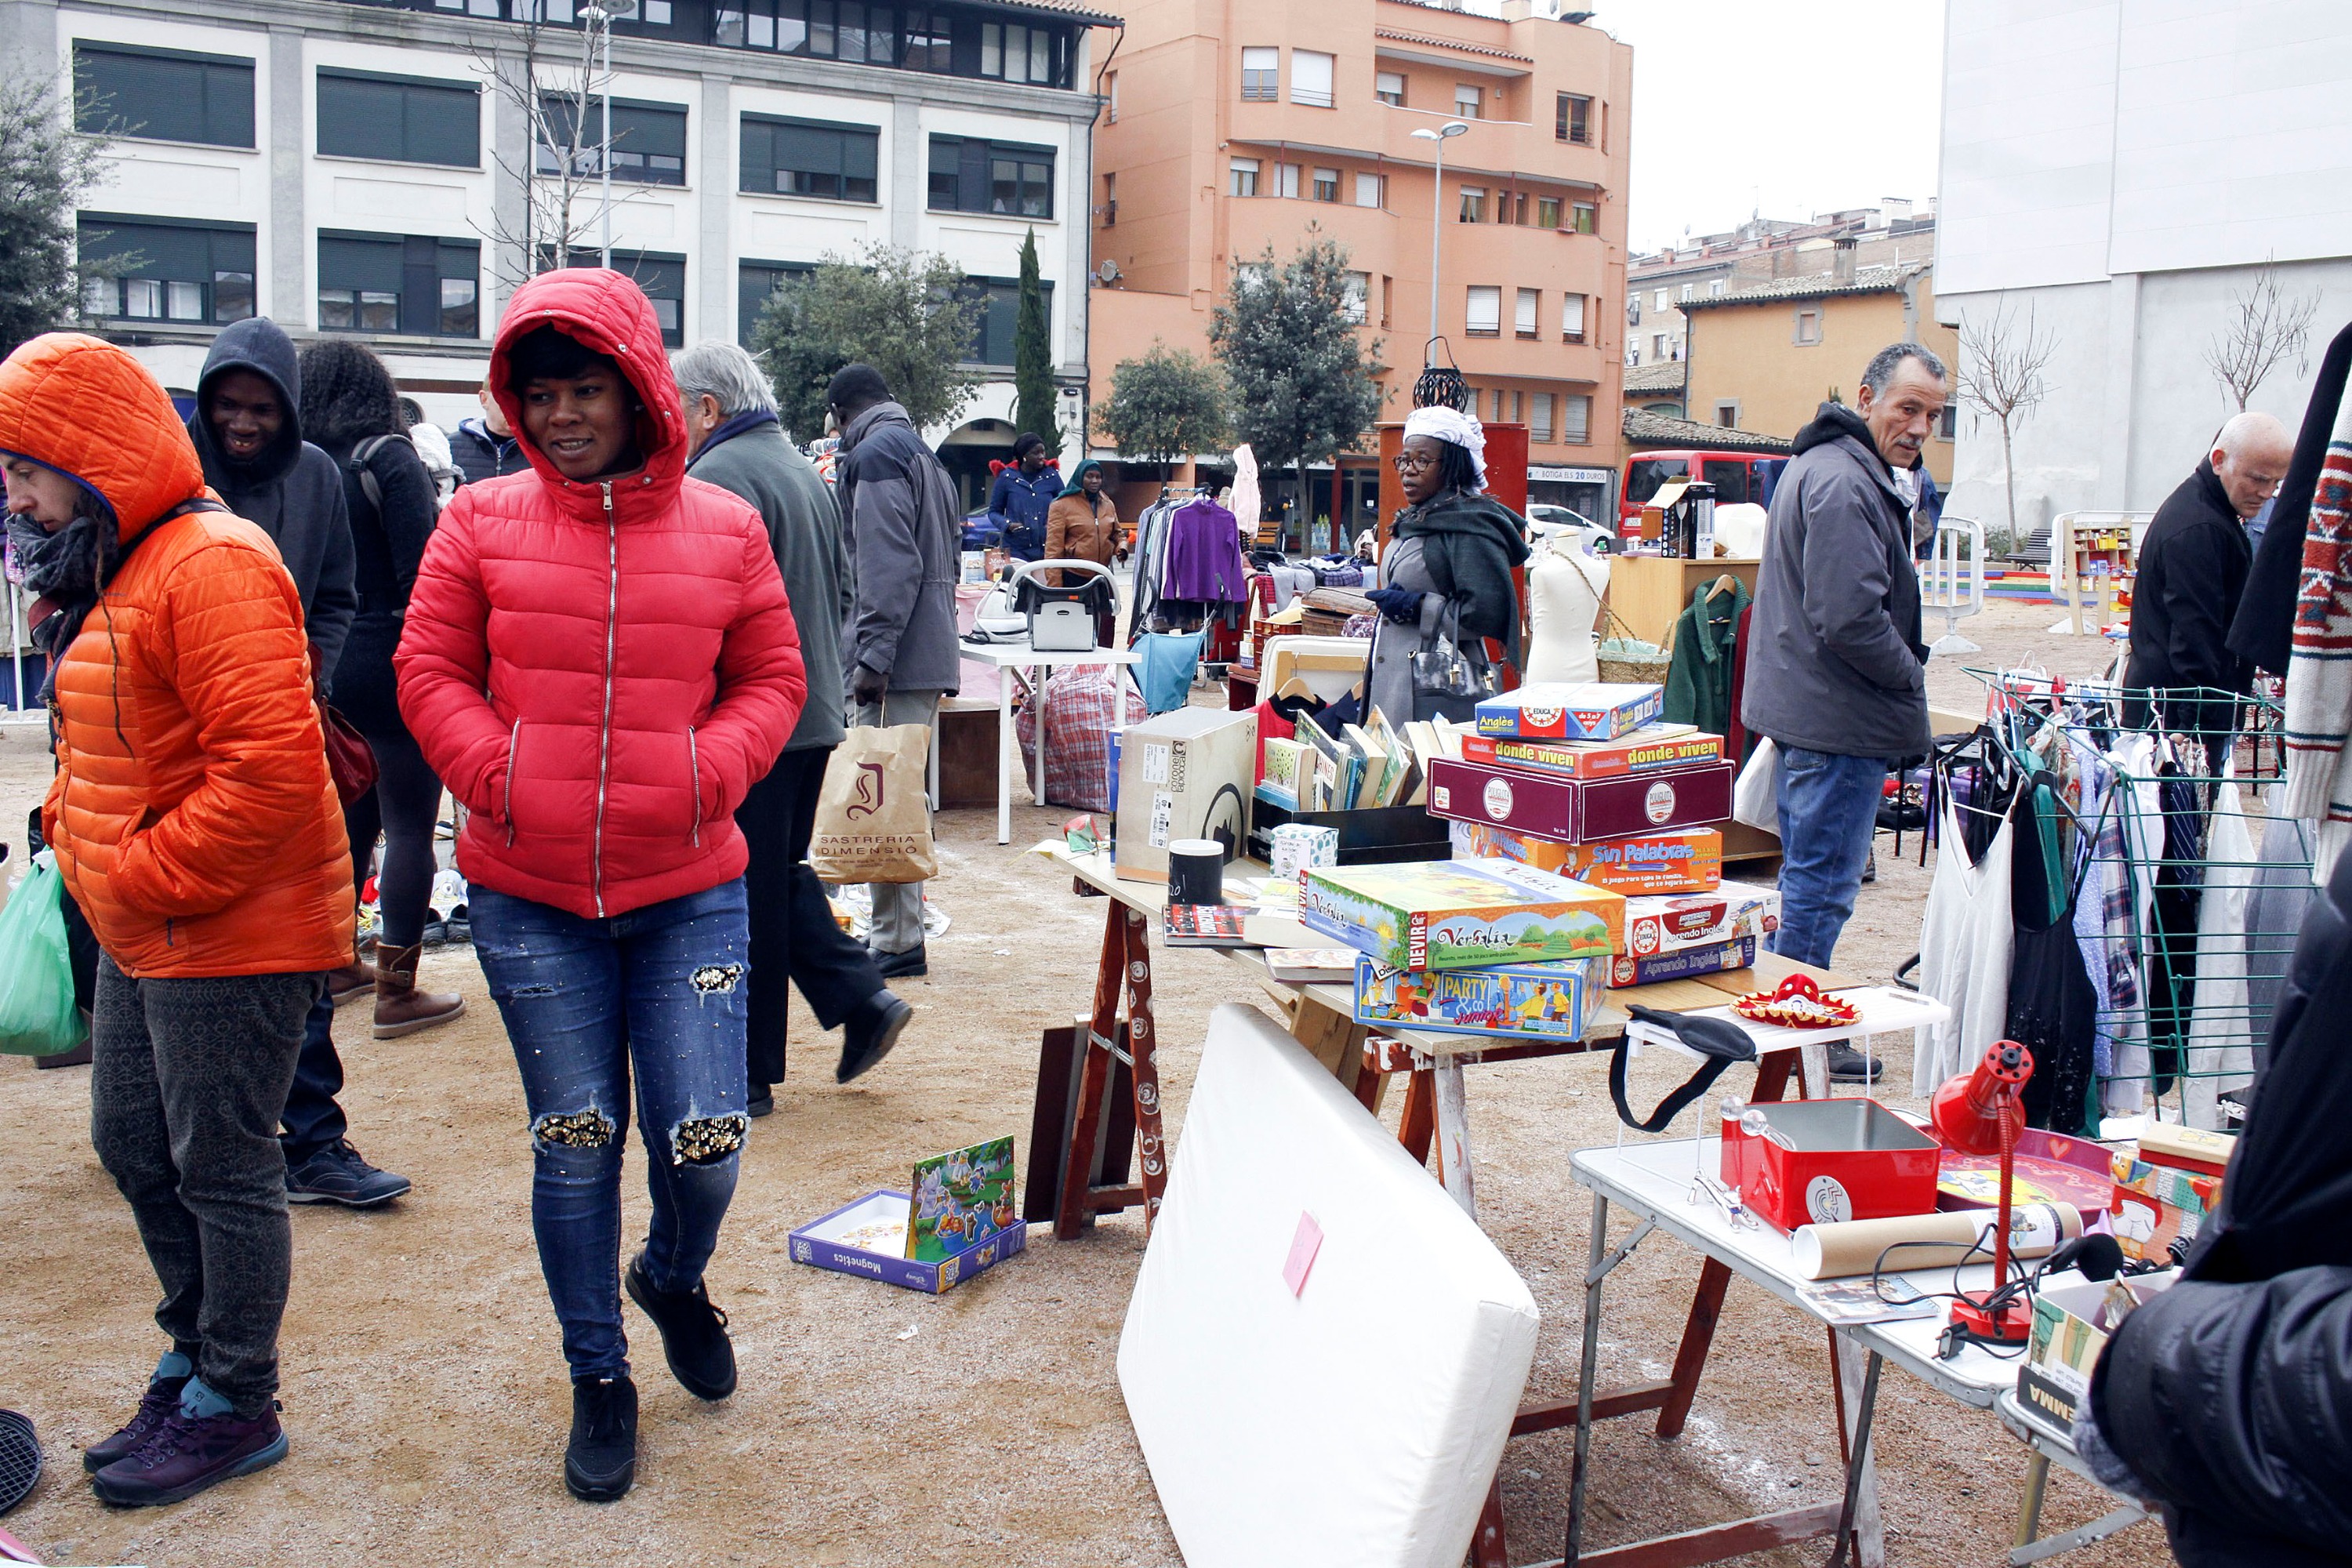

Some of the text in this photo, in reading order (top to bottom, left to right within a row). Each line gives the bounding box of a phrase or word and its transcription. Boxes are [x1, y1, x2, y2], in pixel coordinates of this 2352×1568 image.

[1479, 715, 1515, 728] Anglès
[1495, 742, 1534, 760] donde
[1537, 749, 1574, 767] viven
[1628, 746, 1675, 764] donde
[1678, 742, 1718, 757] viven
[1171, 756, 1179, 792] coronel
[820, 836, 915, 844] SASTRERIA
[821, 845, 916, 855] DIMENSIÓ
[1592, 845, 1621, 863] Sin
[1624, 842, 1695, 862] Palabras
[1298, 884, 1308, 922] DEVIR
[1665, 924, 1725, 944] Aprendo Inglés
[1410, 927, 1427, 966] DEVIR
[1645, 950, 1719, 976] Aprendo Inglés
[1444, 976, 1488, 1000] PARTY
[1455, 996, 1472, 1017] &
[834, 1253, 881, 1274] Magnetics
